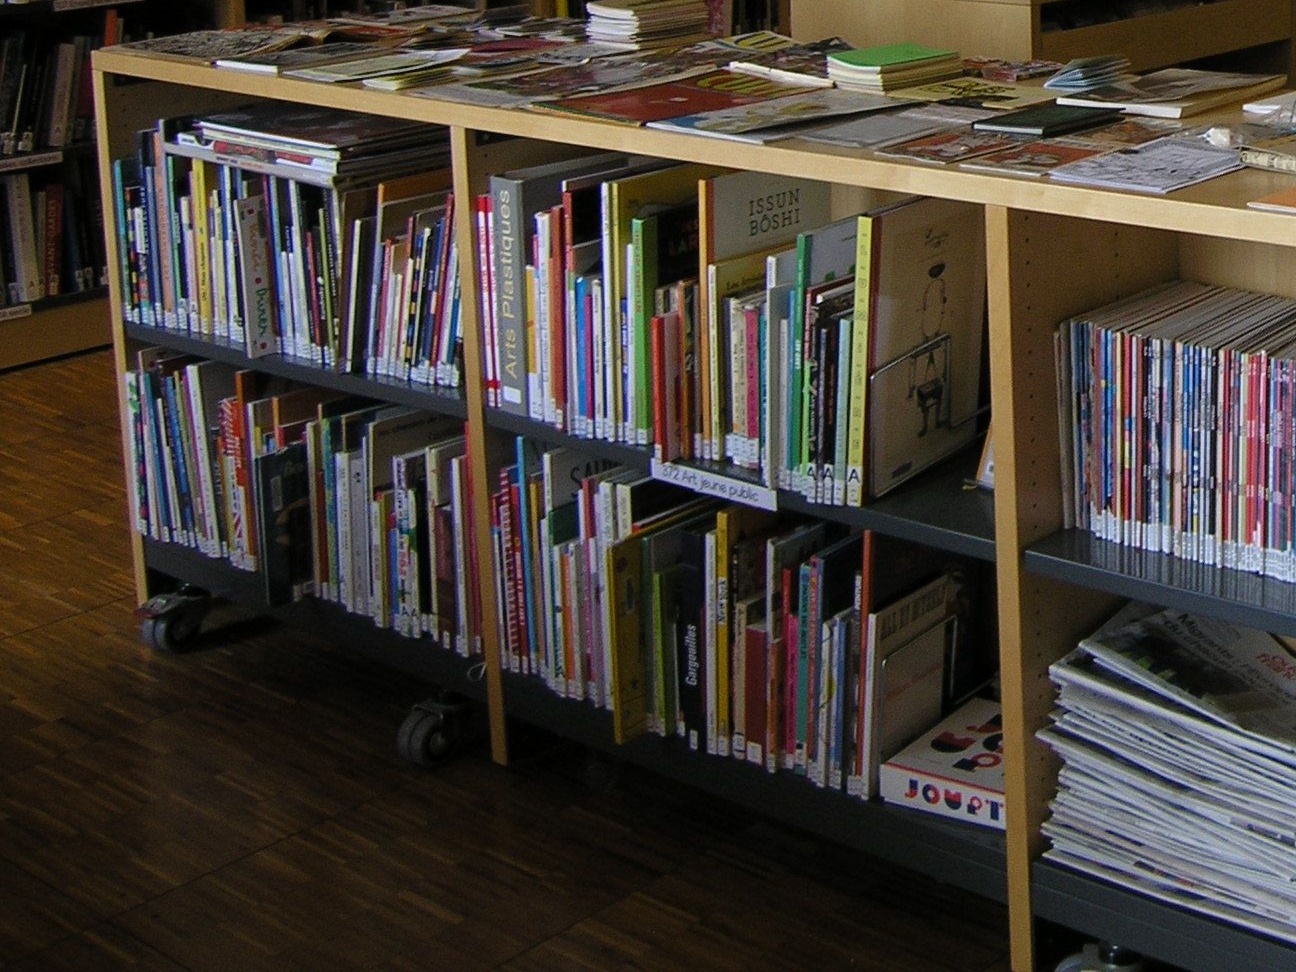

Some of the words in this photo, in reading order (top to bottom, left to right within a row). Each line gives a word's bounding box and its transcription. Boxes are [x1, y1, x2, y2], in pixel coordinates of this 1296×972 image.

[748, 188, 800, 217] ISSUN
[749, 208, 801, 237] BÔSHI
[497, 189, 515, 318] Plastiques
[502, 328, 518, 379] Arts
[662, 465, 680, 481] 372
[729, 486, 759, 501] public
[683, 623, 700, 685] Gargouilles
